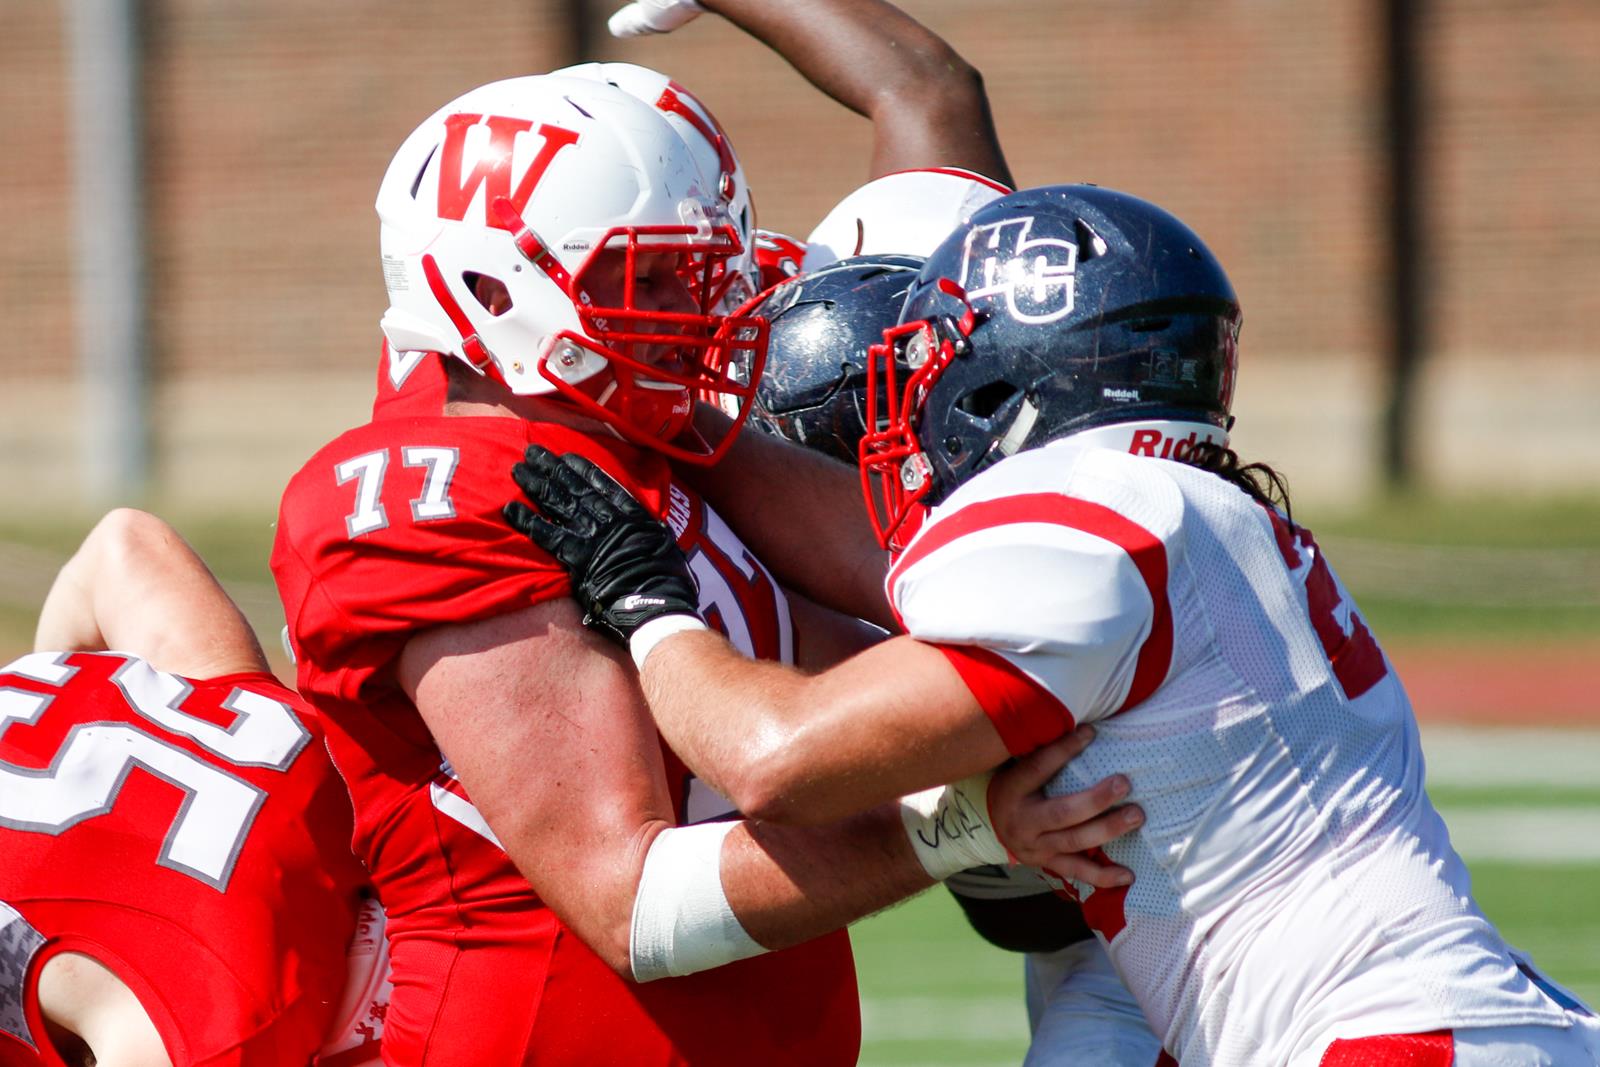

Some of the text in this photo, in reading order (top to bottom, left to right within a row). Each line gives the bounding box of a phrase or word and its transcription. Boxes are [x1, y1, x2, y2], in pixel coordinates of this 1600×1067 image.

[437, 113, 580, 231] W
[1103, 388, 1140, 401] Riddell
[334, 446, 460, 540] 77
